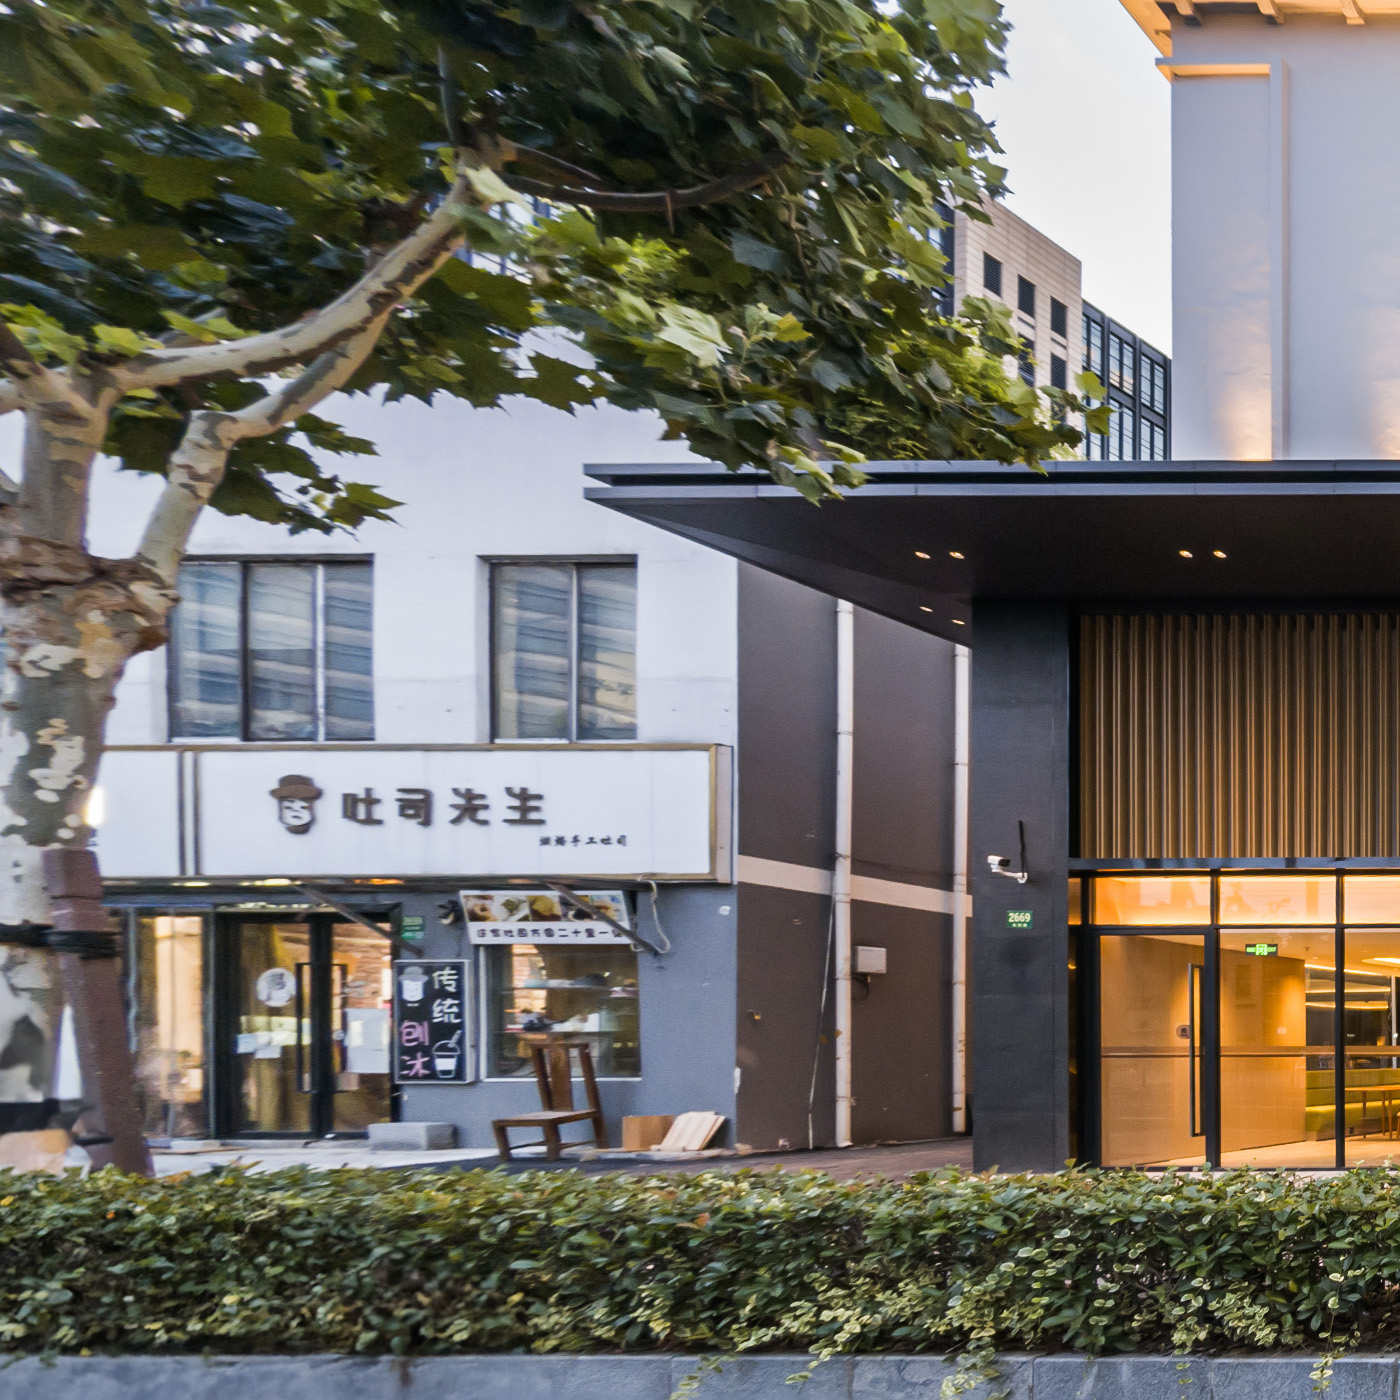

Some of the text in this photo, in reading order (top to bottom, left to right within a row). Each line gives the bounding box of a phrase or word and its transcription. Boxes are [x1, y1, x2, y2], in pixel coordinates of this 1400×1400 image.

[341, 787, 547, 826] 吐司先生
[1008, 912, 1031, 923] 2669
[432, 966, 462, 1024] 传统
